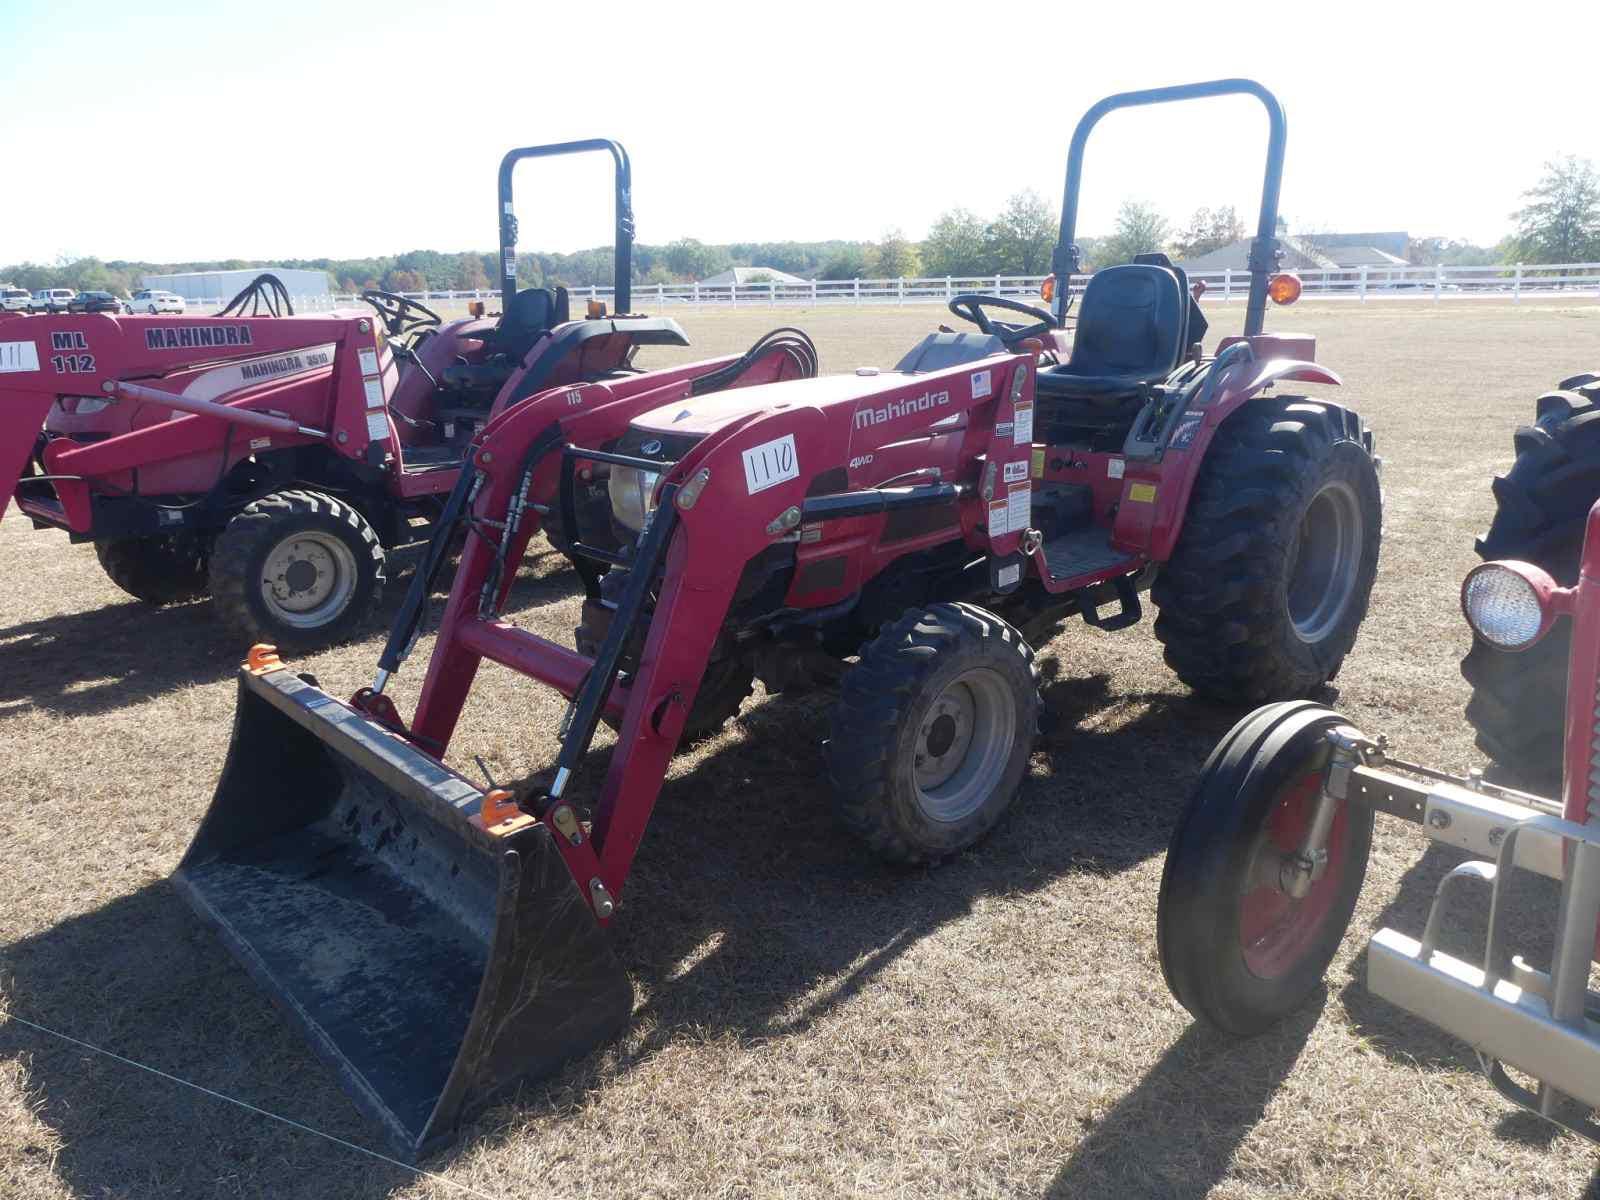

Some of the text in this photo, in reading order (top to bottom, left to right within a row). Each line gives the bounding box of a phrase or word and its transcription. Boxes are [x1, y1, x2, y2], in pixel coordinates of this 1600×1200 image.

[51, 332, 88, 350] ML
[145, 326, 253, 349] MAHINDRA
[51, 355, 96, 373] 112
[241, 353, 302, 380] MAHINDRA
[855, 389, 950, 429] Mahindra
[750, 442, 793, 484] 1110
[849, 454, 873, 469] 4WD
